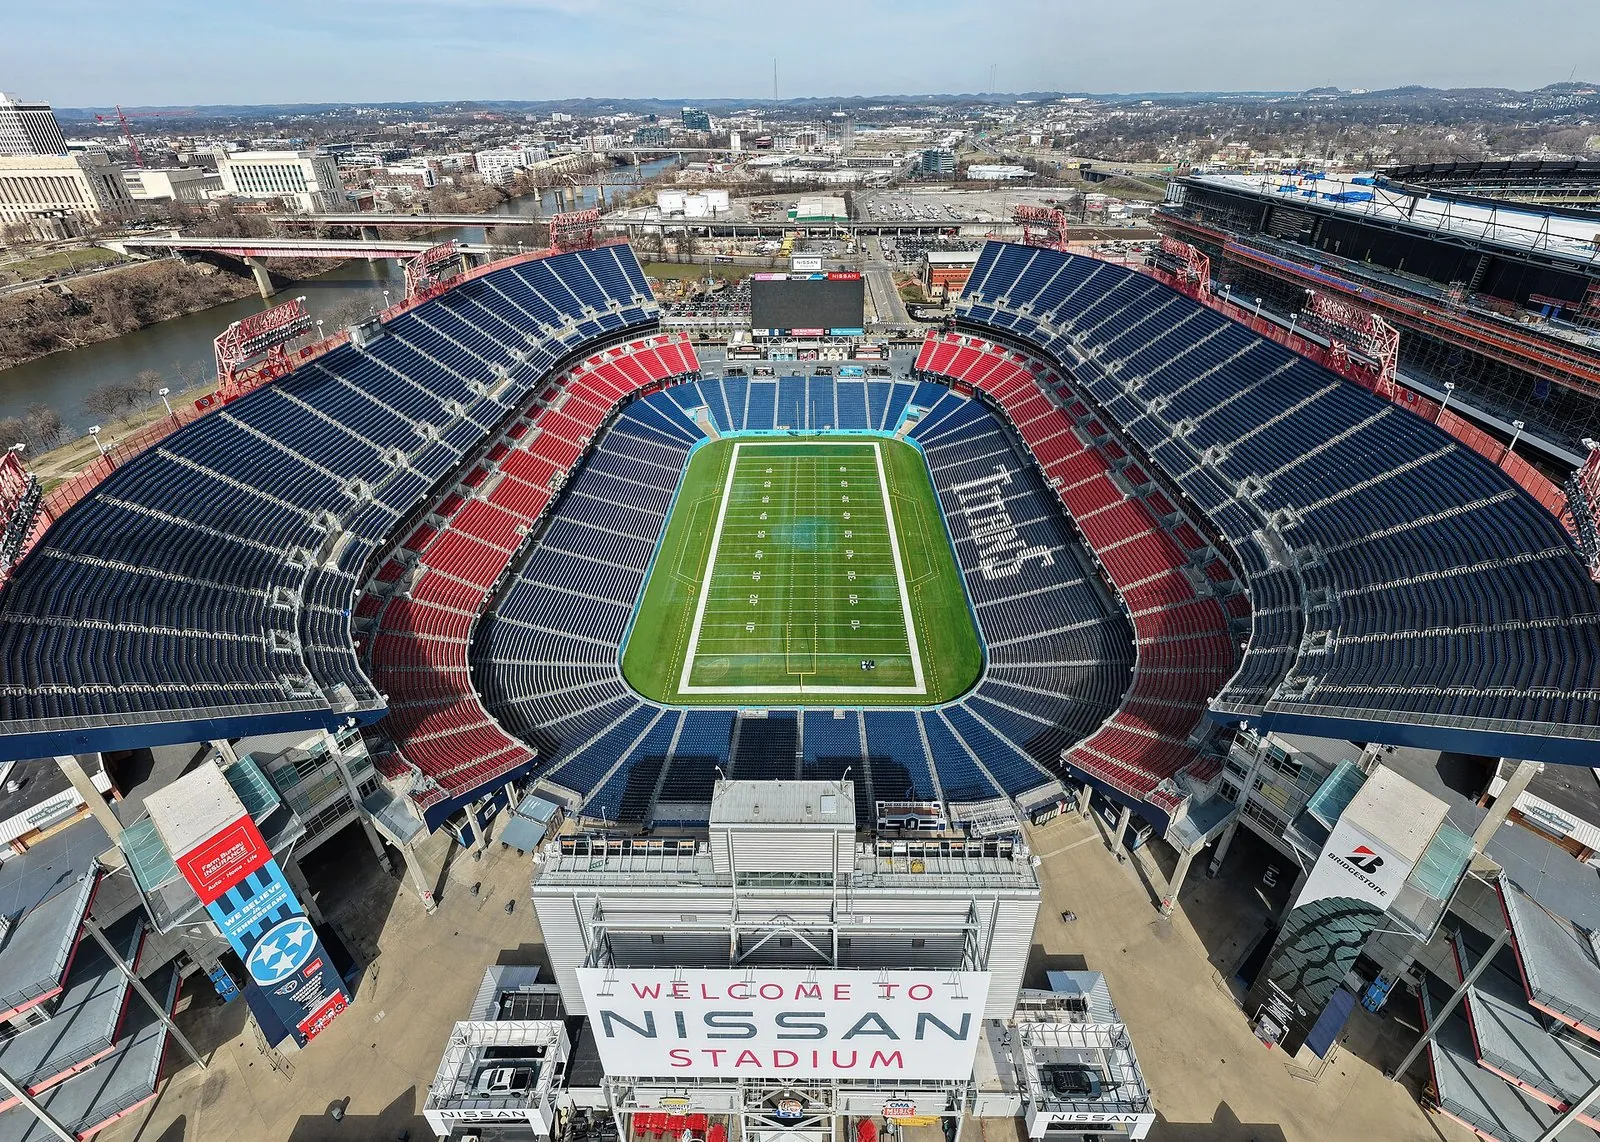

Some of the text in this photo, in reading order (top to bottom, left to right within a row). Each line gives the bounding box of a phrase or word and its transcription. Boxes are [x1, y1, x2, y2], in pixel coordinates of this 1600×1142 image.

[758, 530, 765, 538] 50
[845, 530, 852, 538] 50
[951, 464, 1055, 580] TITANS
[202, 857, 220, 871] Farm
[220, 841, 244, 859] Bureau
[204, 845, 245, 877] INSURANCE
[208, 880, 222, 891] Auto
[226, 865, 243, 877] Home
[247, 854, 258, 863] Life
[1327, 852, 1388, 897] BRIDGESTONE
[224, 881, 282, 927] WE BELIEVE
[231, 892, 288, 937] TENNESSEANS
[631, 983, 934, 1000] WELCOME TO
[600, 1010, 972, 1040] NISSAN
[668, 1048, 904, 1069] STADIUM
[440, 1110, 526, 1118] NISSAN
[1051, 1114, 1139, 1122] NISSAN
